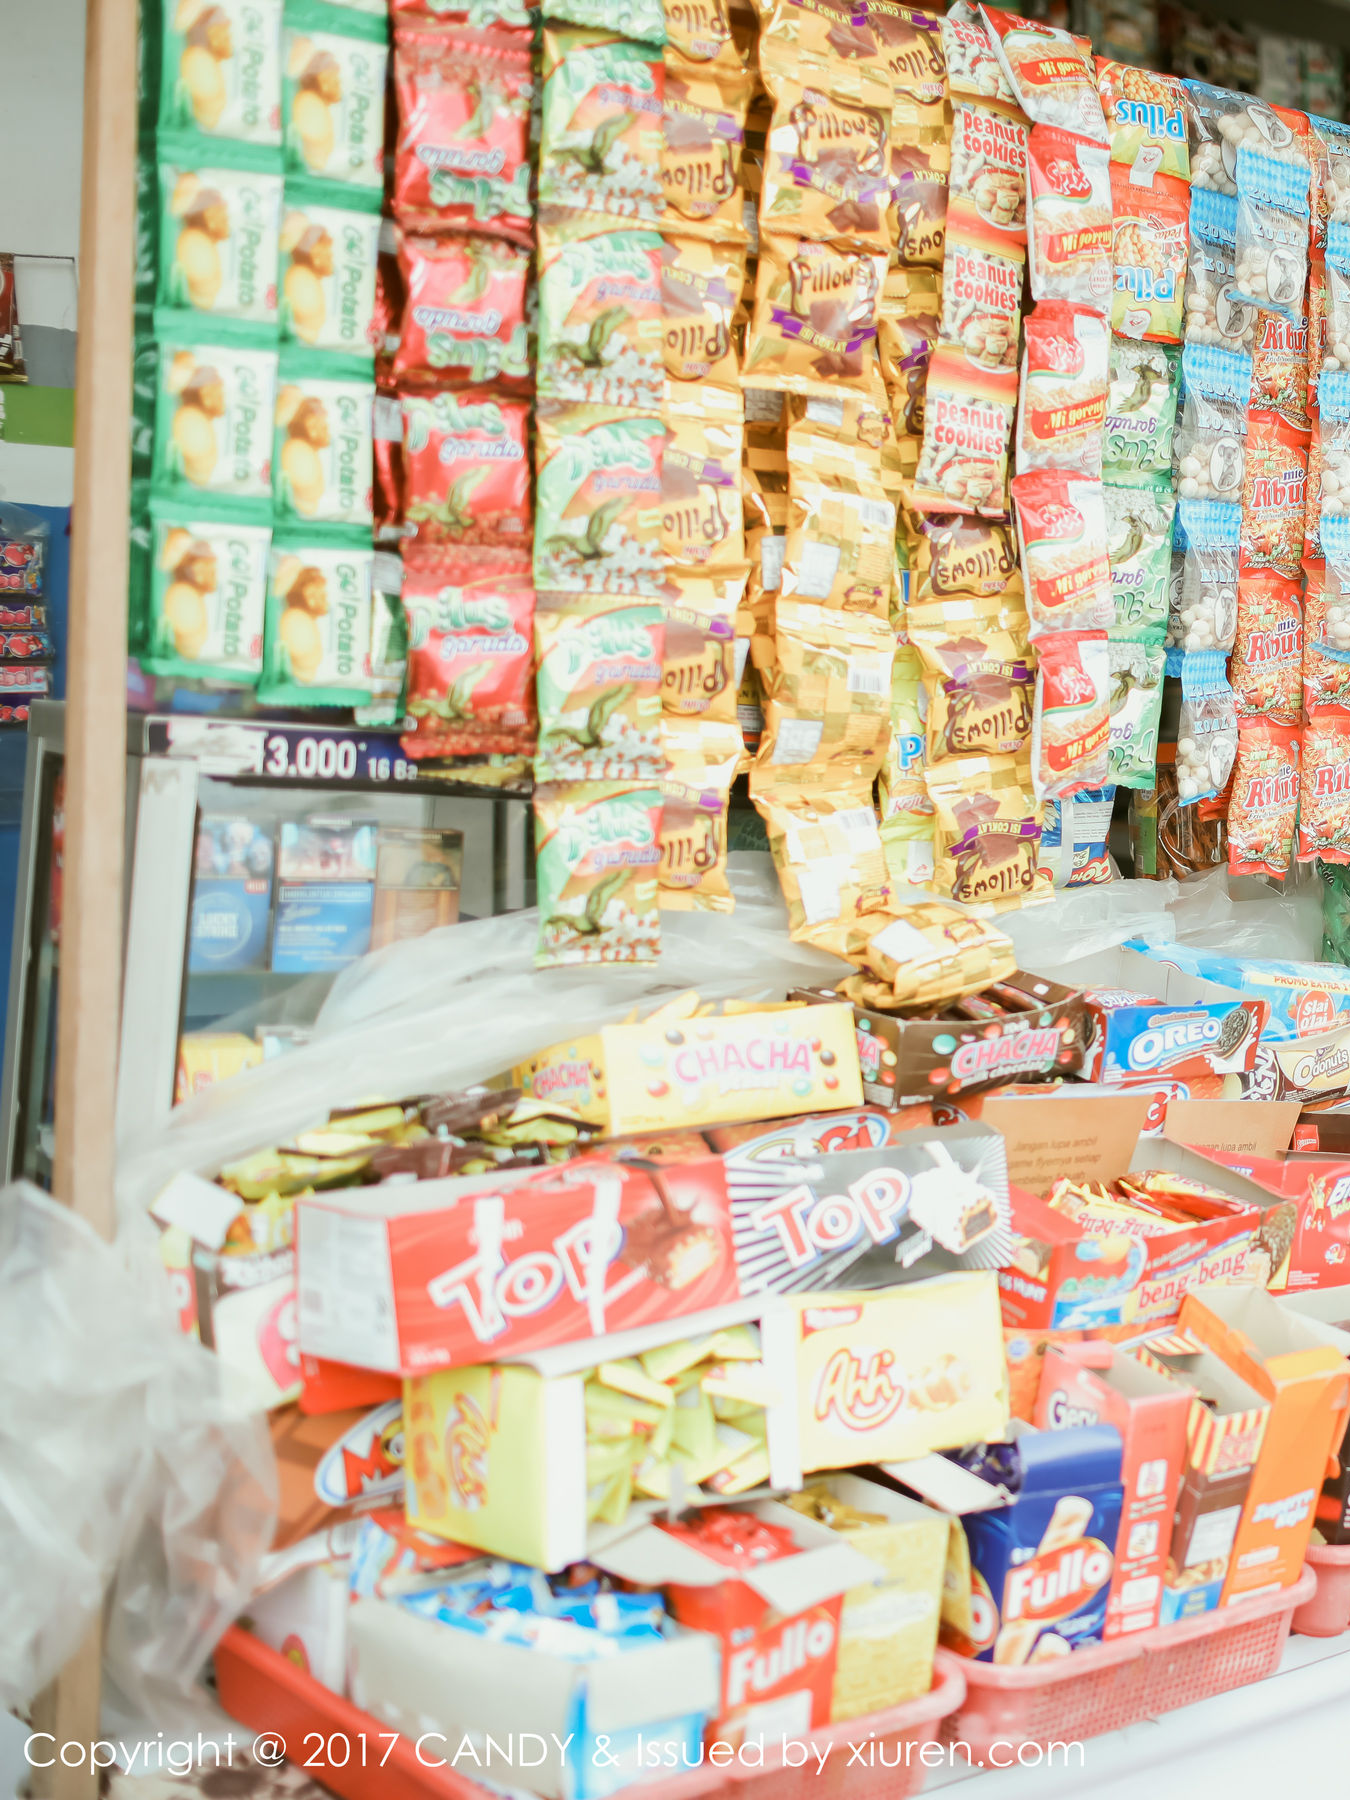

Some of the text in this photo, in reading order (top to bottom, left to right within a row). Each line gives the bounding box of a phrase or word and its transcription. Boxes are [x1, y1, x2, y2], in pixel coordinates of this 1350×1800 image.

[963, 109, 1025, 147] peanut
[1116, 99, 1187, 141] Pilus
[962, 133, 1027, 169] cookies
[954, 252, 1017, 289] peanut
[954, 279, 1018, 311] cookies
[936, 399, 1005, 435] peanut
[935, 426, 1004, 455] cookies
[1273, 976, 1309, 988] PROMO
[674, 1041, 811, 1082] CHACHA
[955, 1030, 1059, 1076] CHACHA
[1134, 1020, 1221, 1069] OREO
[1138, 1249, 1247, 1310] beng-beng
[1007, 1549, 1113, 1620] Fullo
[727, 1619, 836, 1707] Fullo
